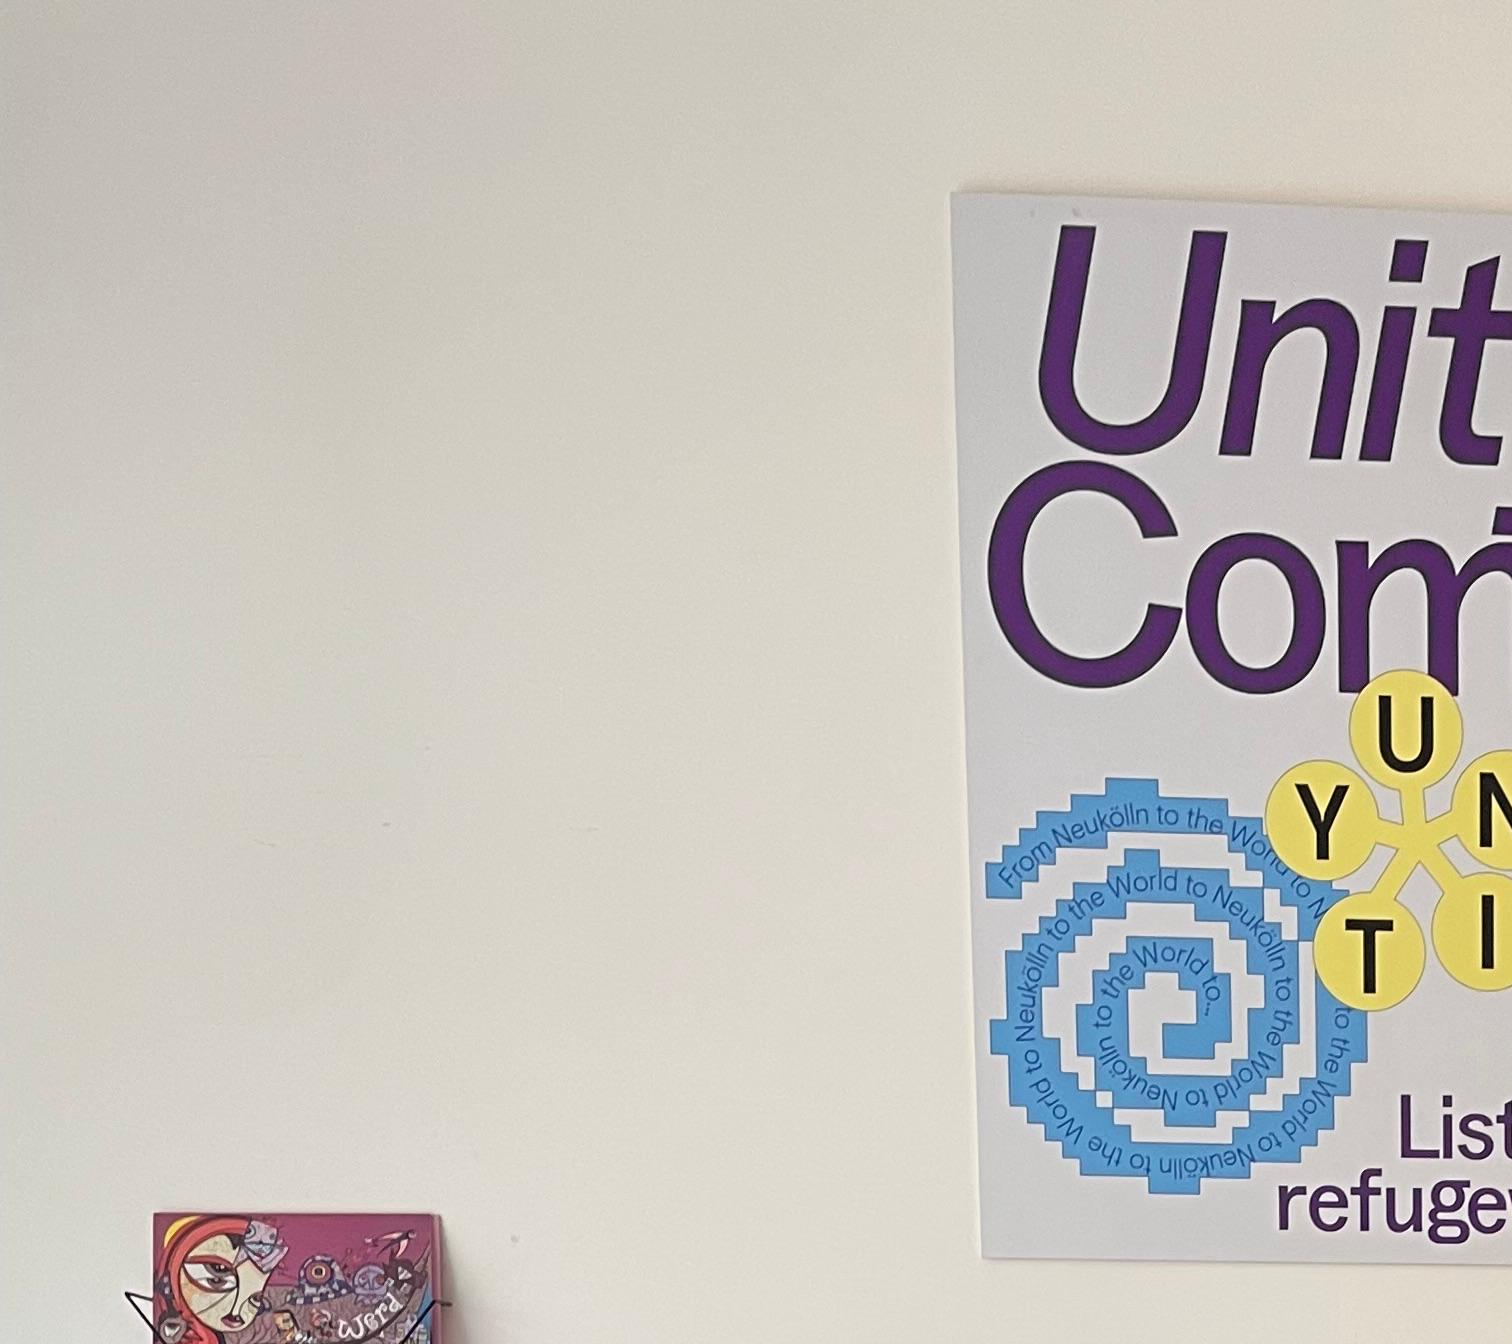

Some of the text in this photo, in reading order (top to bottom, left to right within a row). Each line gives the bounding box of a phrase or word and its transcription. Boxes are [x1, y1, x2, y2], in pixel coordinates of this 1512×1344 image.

[1052, 803, 1149, 848] Neukölln
[1157, 805, 1179, 825] to
[1187, 808, 1223, 833] the
[998, 841, 1053, 889] From
[1107, 869, 1178, 898] World
[1186, 875, 1207, 898] to
[1290, 876, 1311, 898] to
[1068, 891, 1105, 920] the
[1046, 919, 1070, 941] to
[1212, 885, 1285, 972] Neukölln
[1132, 942, 1209, 975] World
[1014, 942, 1054, 1042] Neukölln
[1101, 964, 1134, 999] the
[1275, 976, 1293, 1001] to
[1092, 1005, 1112, 1029] to
[1266, 1009, 1293, 1046] the
[1024, 1049, 1043, 1074] to
[1324, 1037, 1350, 1073] the
[1099, 1036, 1178, 1111] Neukölln
[1214, 1051, 1277, 1105] World
[1029, 1077, 1084, 1145] World
[1185, 1089, 1209, 1107] to
[1281, 1080, 1337, 1142] World
[1088, 1136, 1123, 1166] the
[1258, 1132, 1282, 1151] to
[1129, 1154, 1151, 1174] to
[1159, 1144, 1257, 1180] Neukölln
